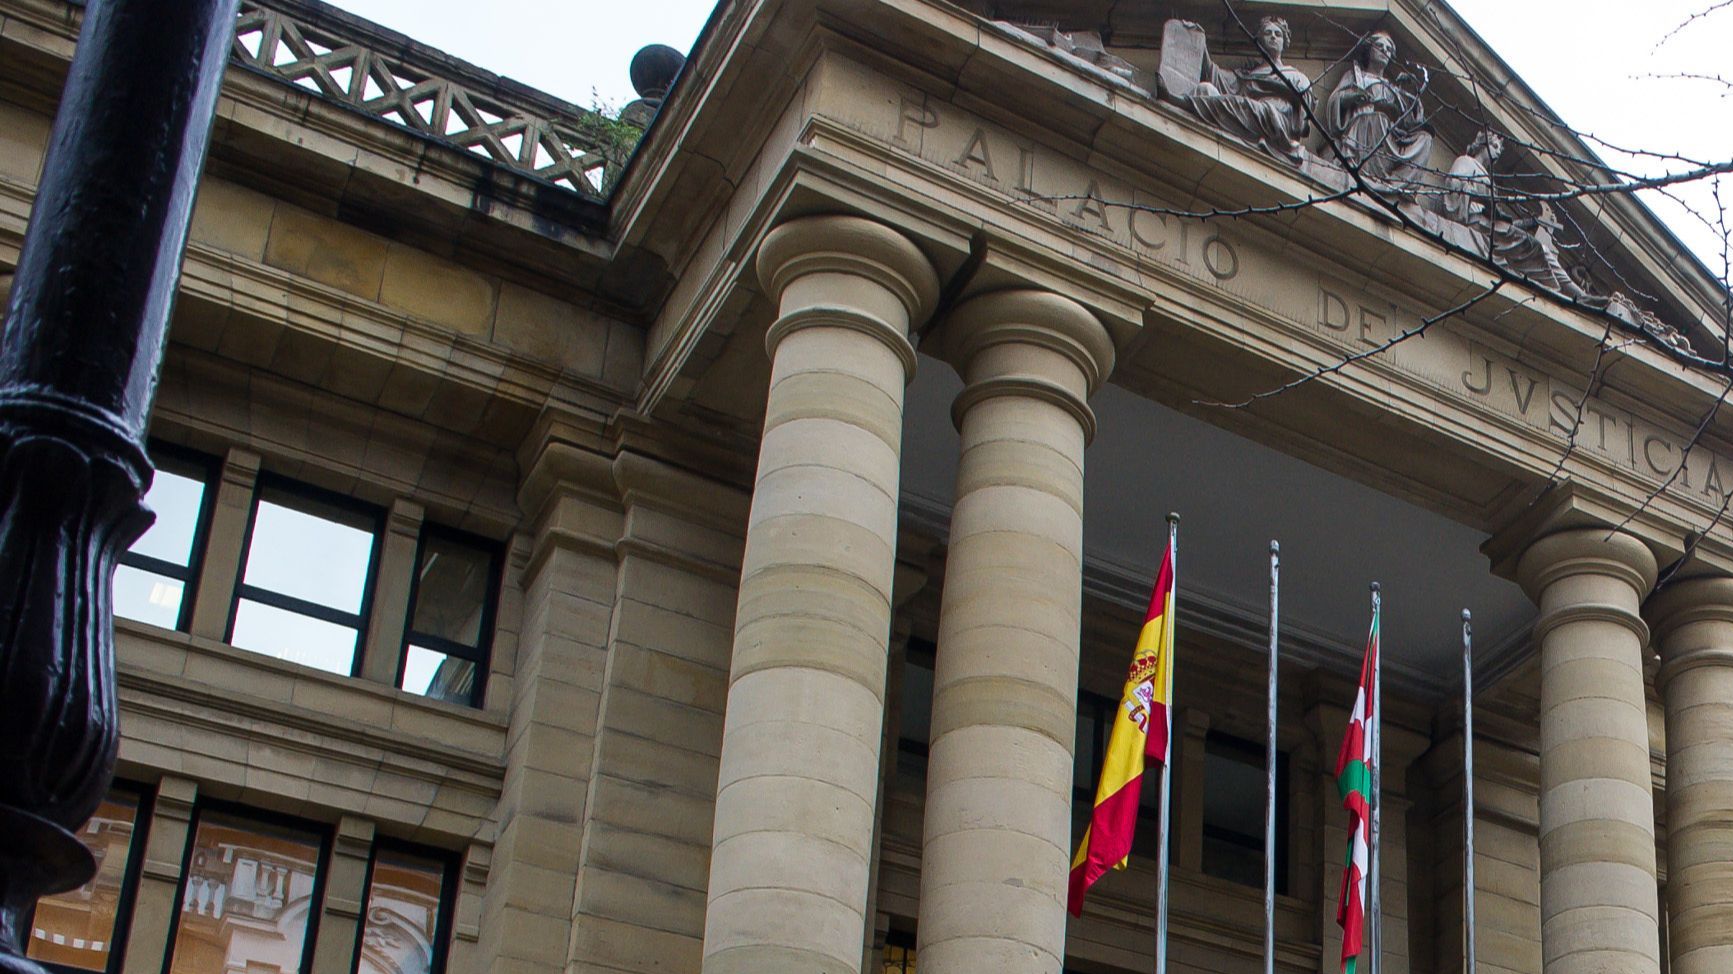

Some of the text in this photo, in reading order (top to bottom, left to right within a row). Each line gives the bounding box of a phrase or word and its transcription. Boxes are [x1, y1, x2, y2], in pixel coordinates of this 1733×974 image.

[893, 97, 1729, 498] PALACIO DE JVSTICIA
